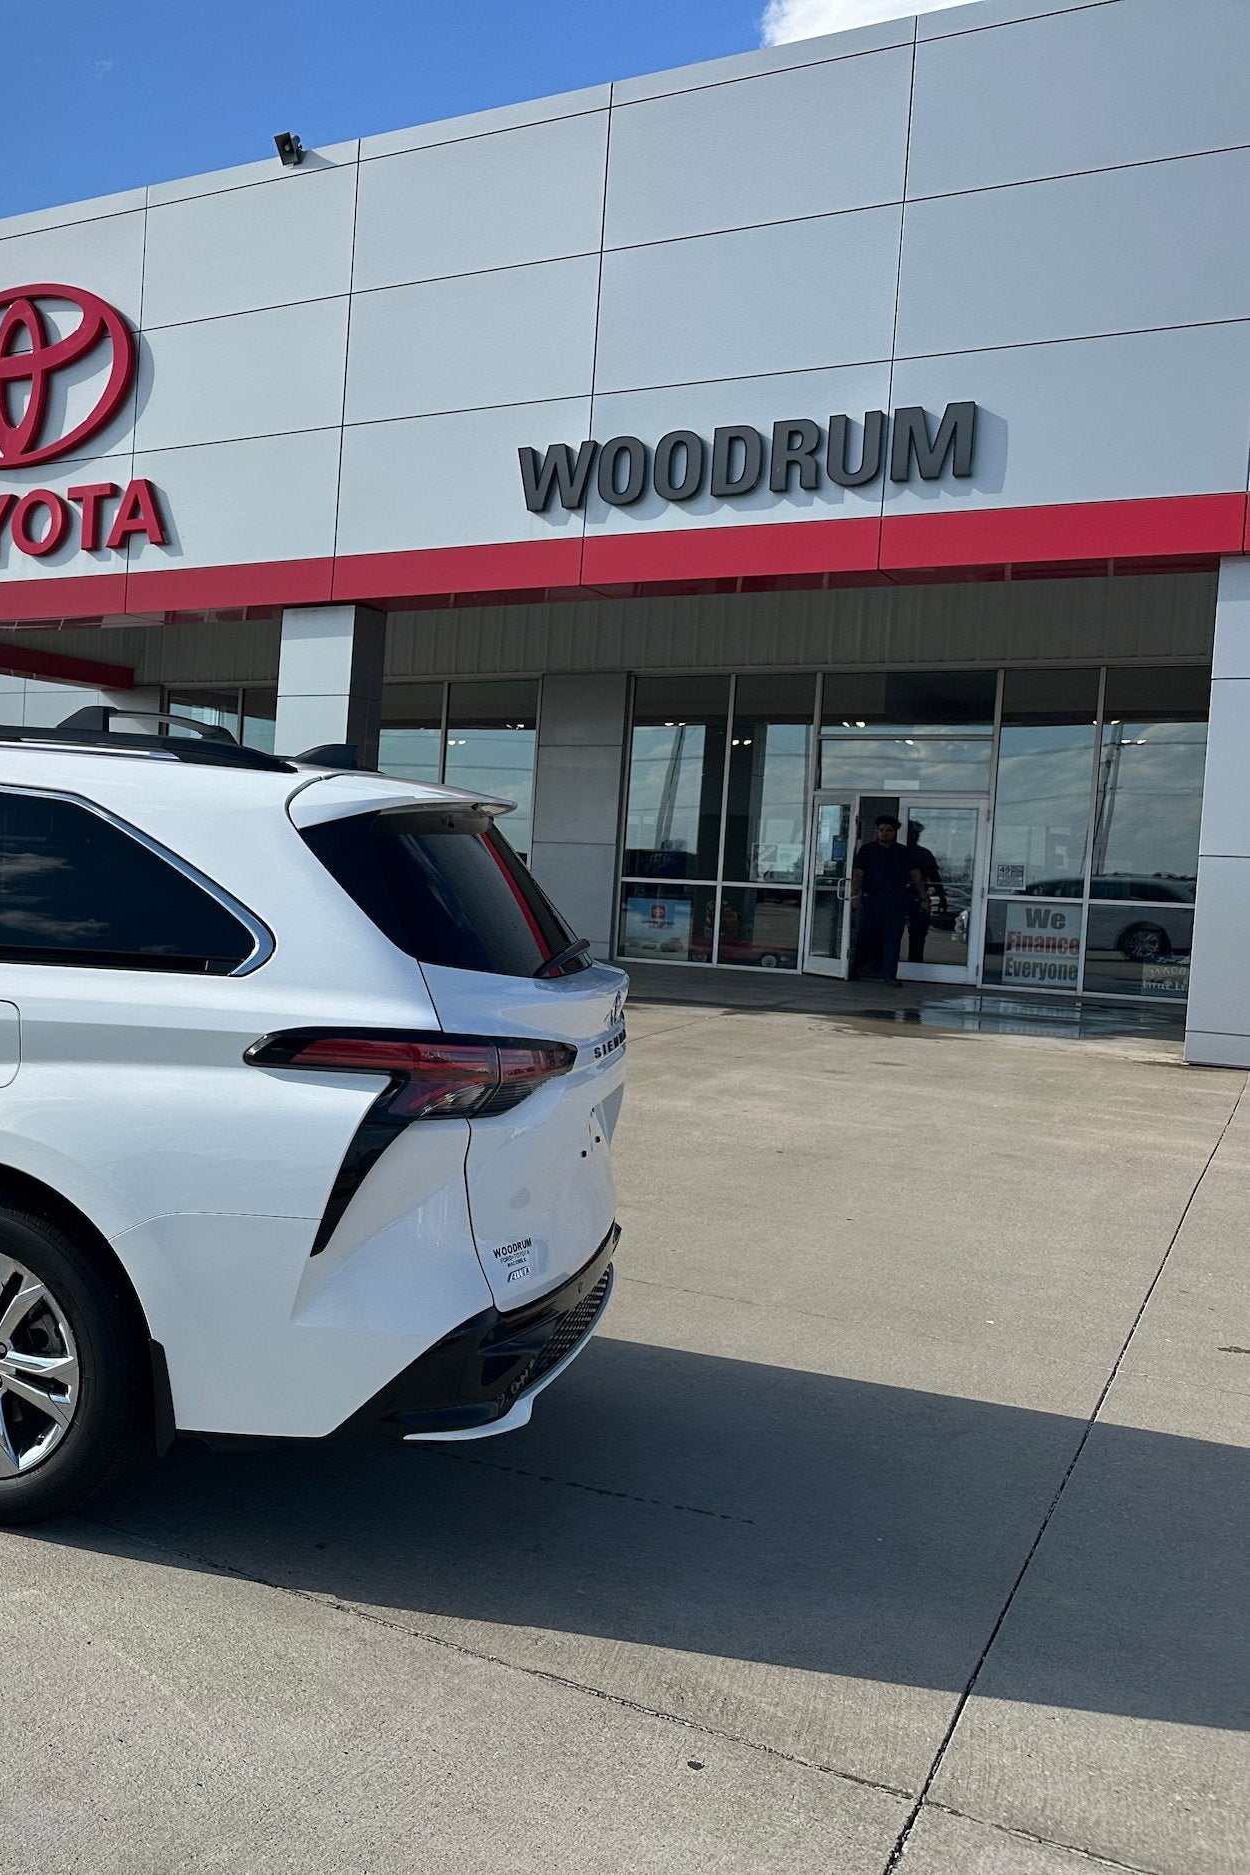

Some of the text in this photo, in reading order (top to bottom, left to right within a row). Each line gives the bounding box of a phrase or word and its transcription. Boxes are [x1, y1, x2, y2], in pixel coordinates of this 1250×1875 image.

[518, 401, 977, 512] WOODRUM
[1025, 908, 1066, 929] We
[1006, 931, 1080, 955] Finance
[1004, 958, 1078, 981] Everyone
[493, 1237, 532, 1258] WOODRUM
[508, 1266, 531, 1282] AWD
